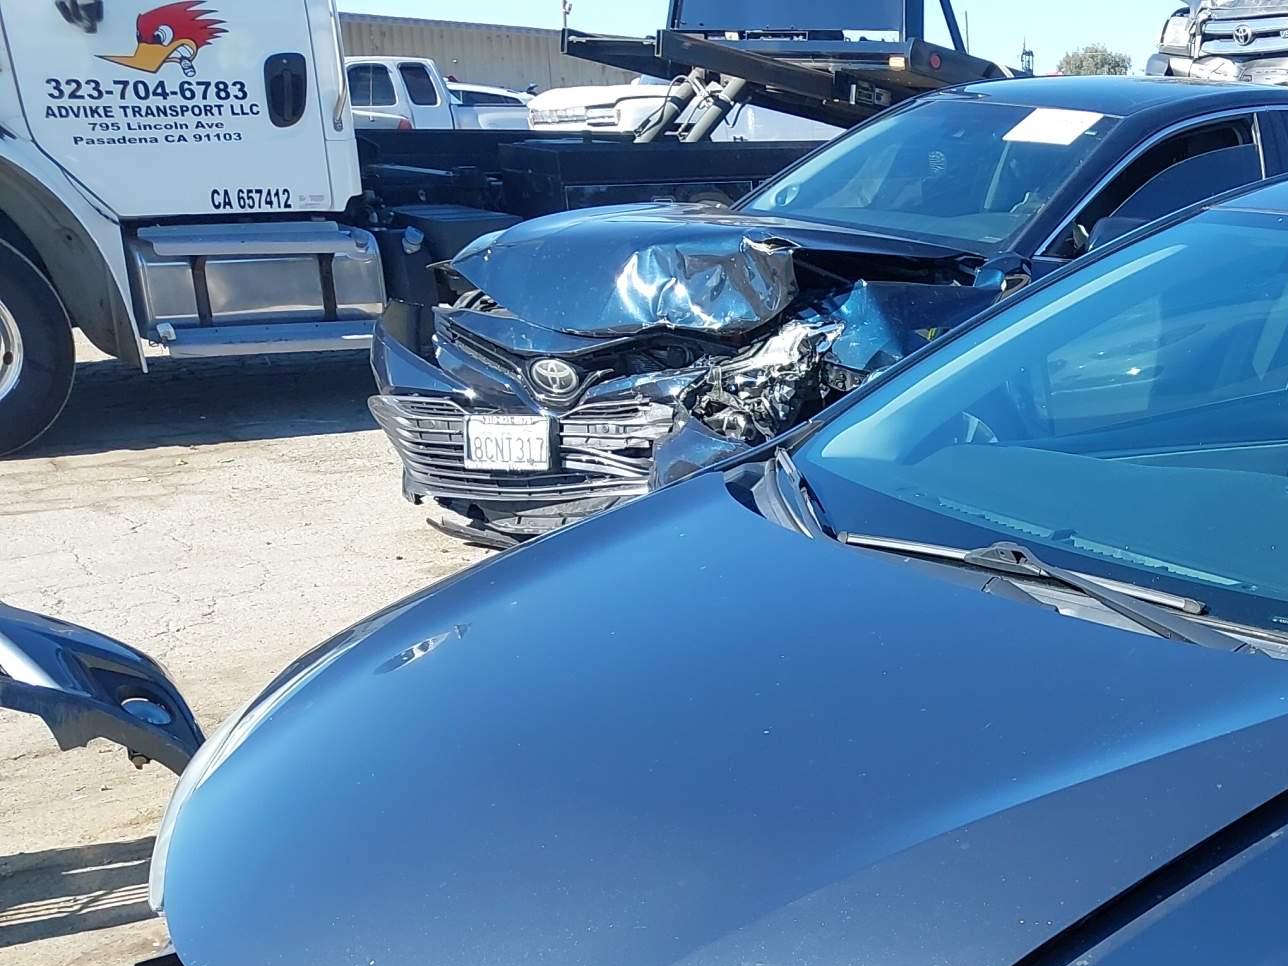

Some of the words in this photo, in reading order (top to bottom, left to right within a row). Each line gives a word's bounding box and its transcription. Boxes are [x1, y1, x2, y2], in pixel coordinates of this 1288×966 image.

[46, 79, 248, 100] 323-704-6783
[46, 105, 115, 118] ADVIKE
[119, 104, 224, 117] TRANSPORT
[230, 103, 260, 116] LLC
[88, 122, 121, 131] 795
[126, 121, 189, 131] Lincoln
[195, 120, 225, 130] Ave
[73, 135, 158, 145] Pasadena
[164, 134, 188, 143] CA
[193, 132, 242, 142] 91103
[211, 188, 234, 210] CA
[237, 188, 292, 209] 657412
